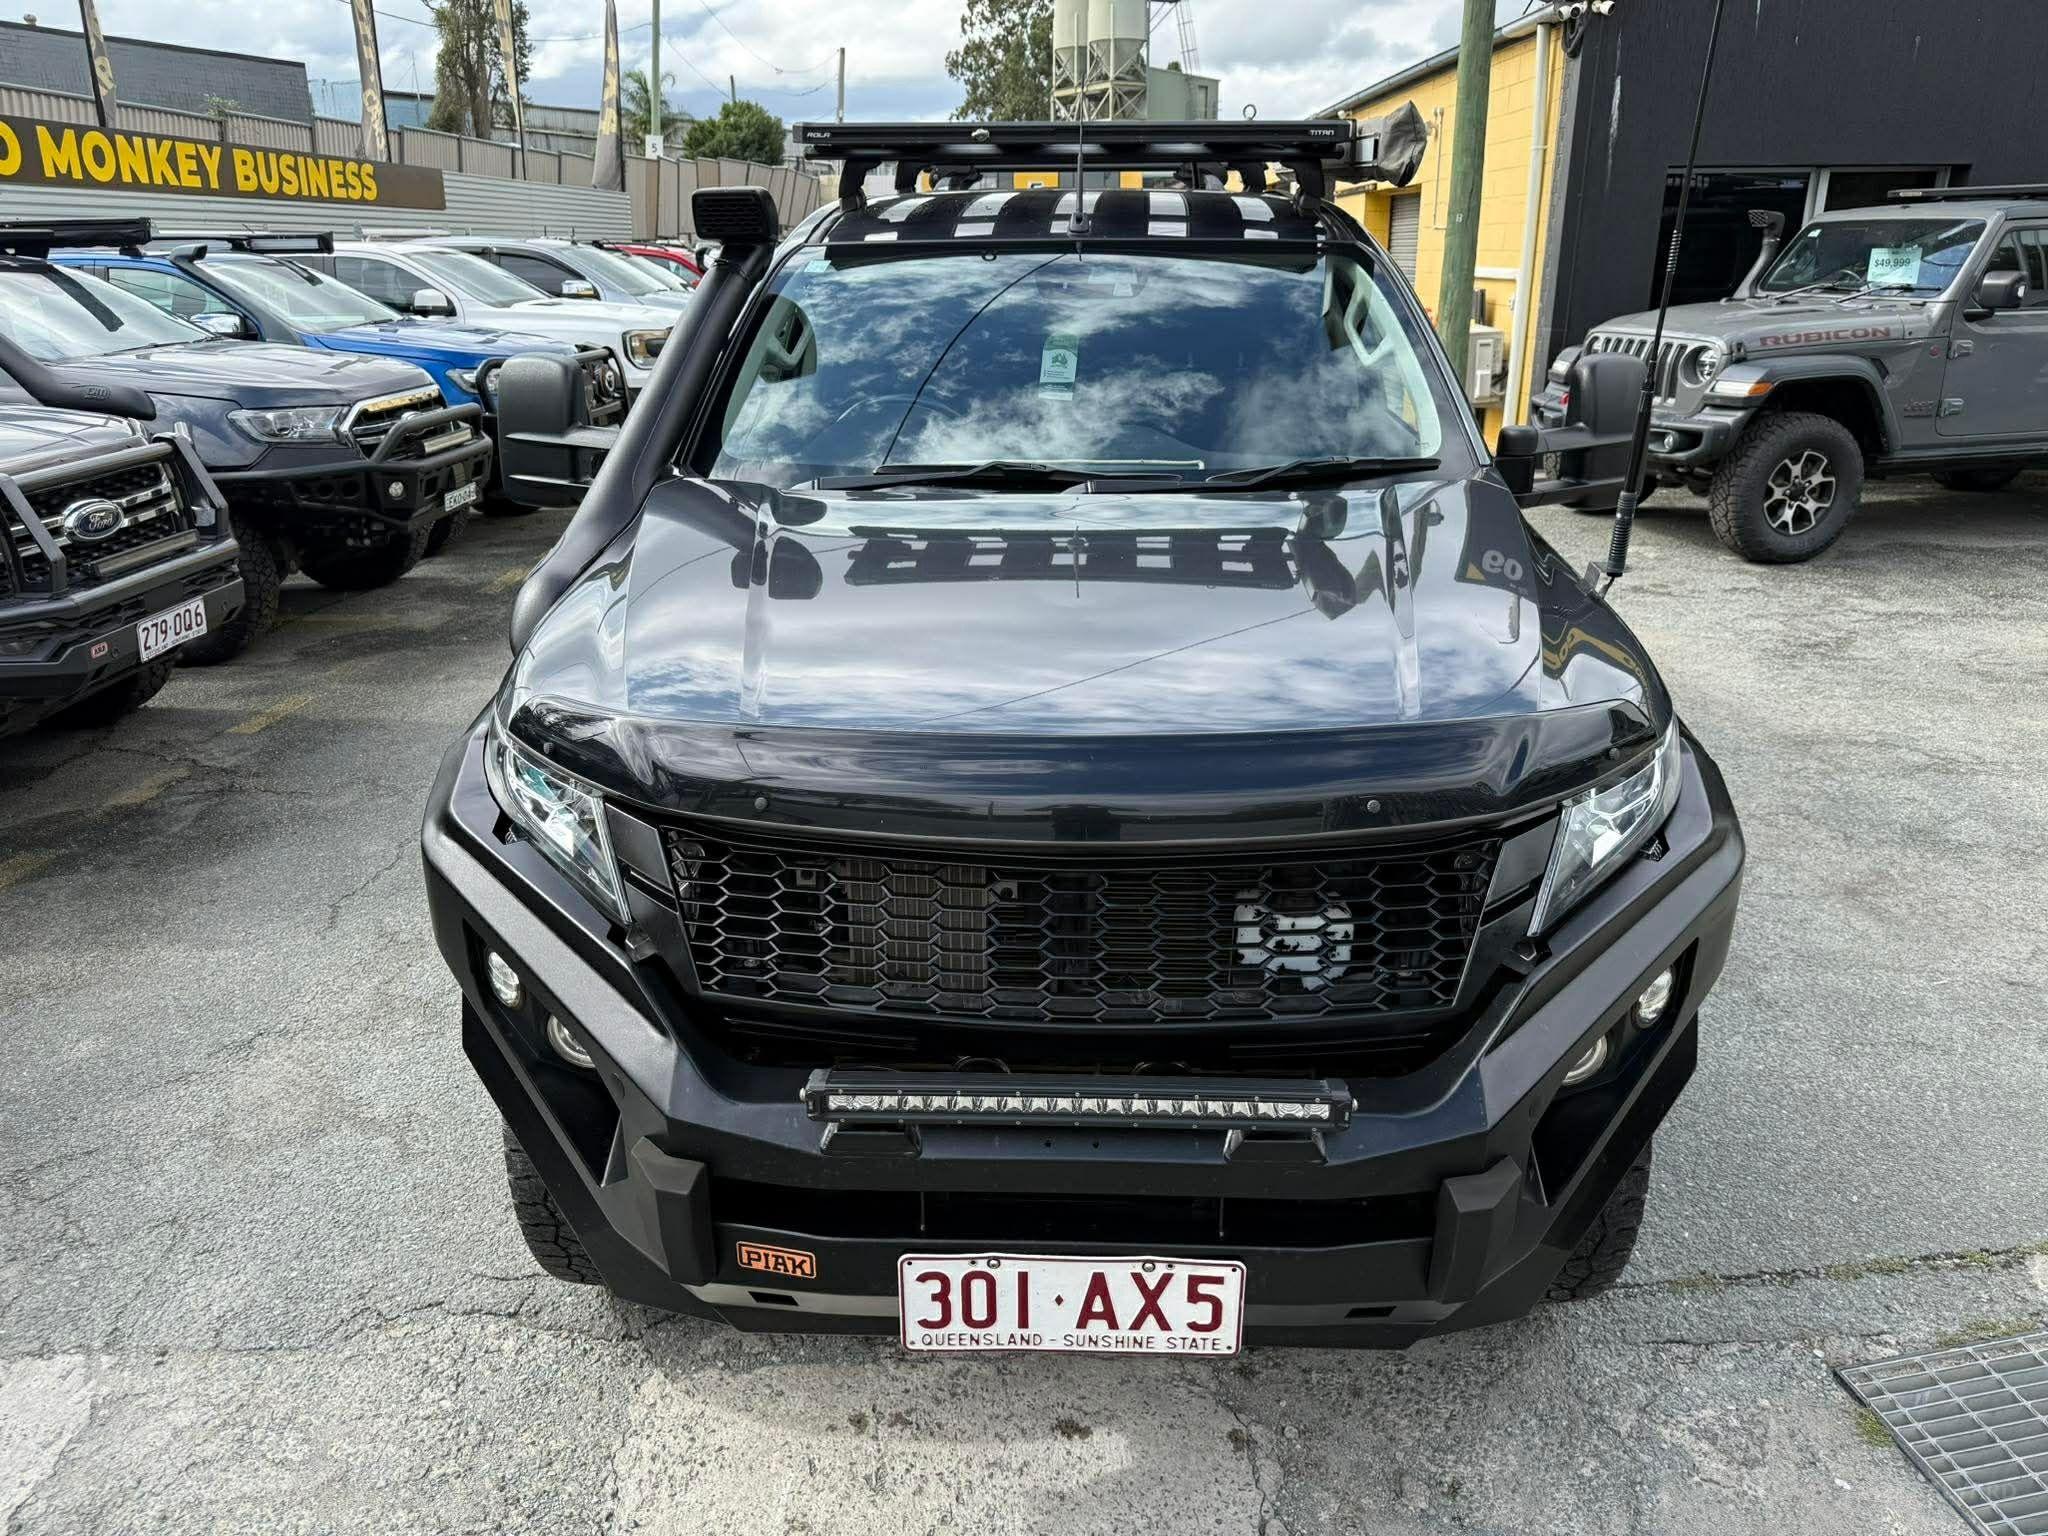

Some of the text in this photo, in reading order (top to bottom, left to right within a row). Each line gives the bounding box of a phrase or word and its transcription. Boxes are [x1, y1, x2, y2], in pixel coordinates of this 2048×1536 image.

[651, 143, 658, 153] 5
[36, 125, 221, 190] MONKEY
[233, 148, 378, 201] BUSINESS
[1874, 257, 1911, 268] $49,999
[1759, 327, 1891, 346] RUBICON
[89, 512, 113, 531] Ford
[745, 1249, 811, 1276] PIAK
[921, 1333, 1043, 1347] QUEENSLAND
[1063, 1335, 1155, 1349] SUNSHINE
[1167, 1337, 1221, 1351] STATE
